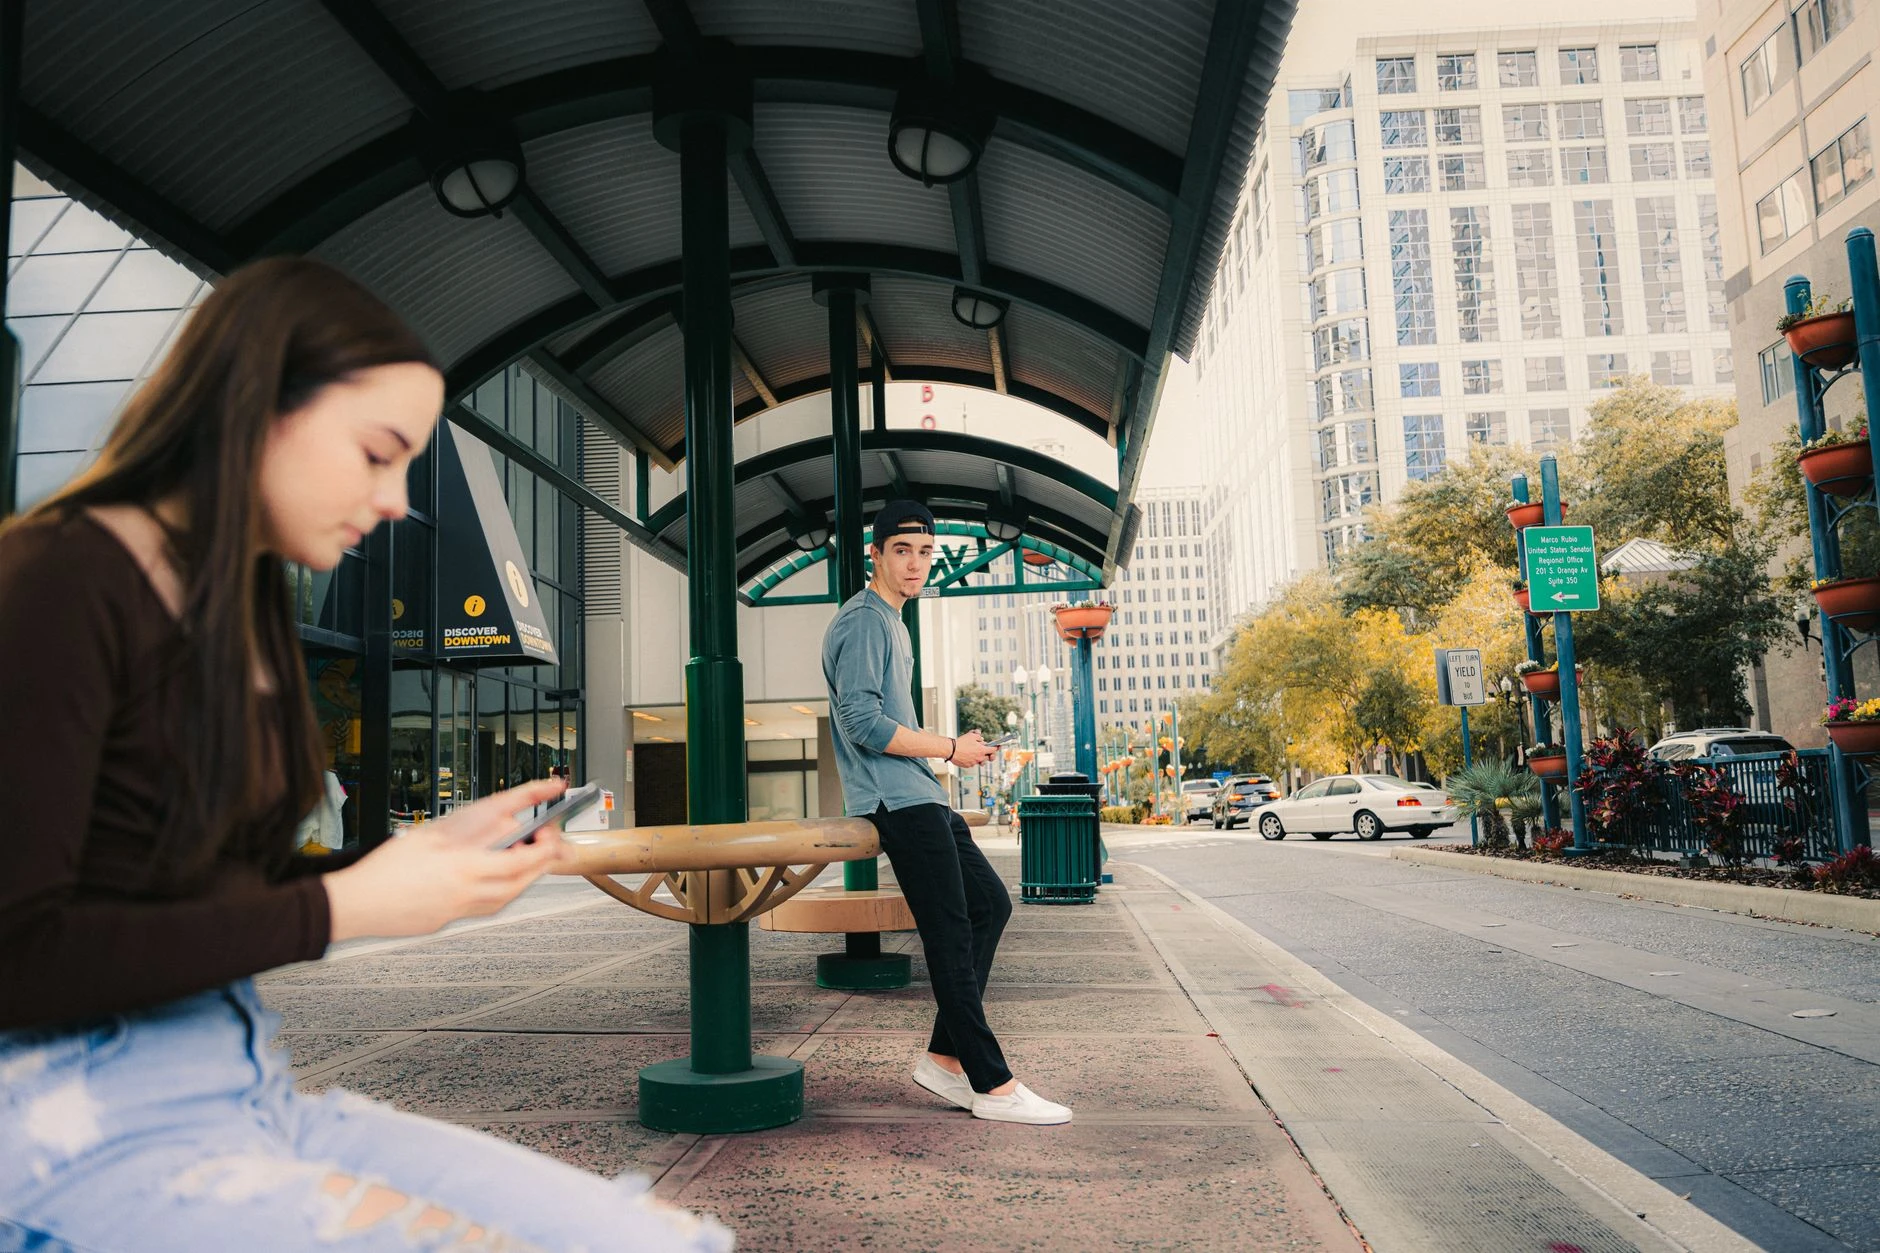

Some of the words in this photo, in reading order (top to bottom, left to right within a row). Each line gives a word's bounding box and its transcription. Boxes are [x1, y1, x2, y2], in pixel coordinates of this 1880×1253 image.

[1570, 545, 1592, 553] Senator
[1539, 557, 1564, 565] Regional
[1536, 567, 1547, 575] 201
[1557, 567, 1578, 575] Orange
[1548, 577, 1563, 585] Suite
[444, 626, 498, 637] DISCOVER
[444, 635, 511, 646] DOWNTOWN
[1455, 666, 1475, 677] YIELD
[1463, 692, 1473, 700] BUS
